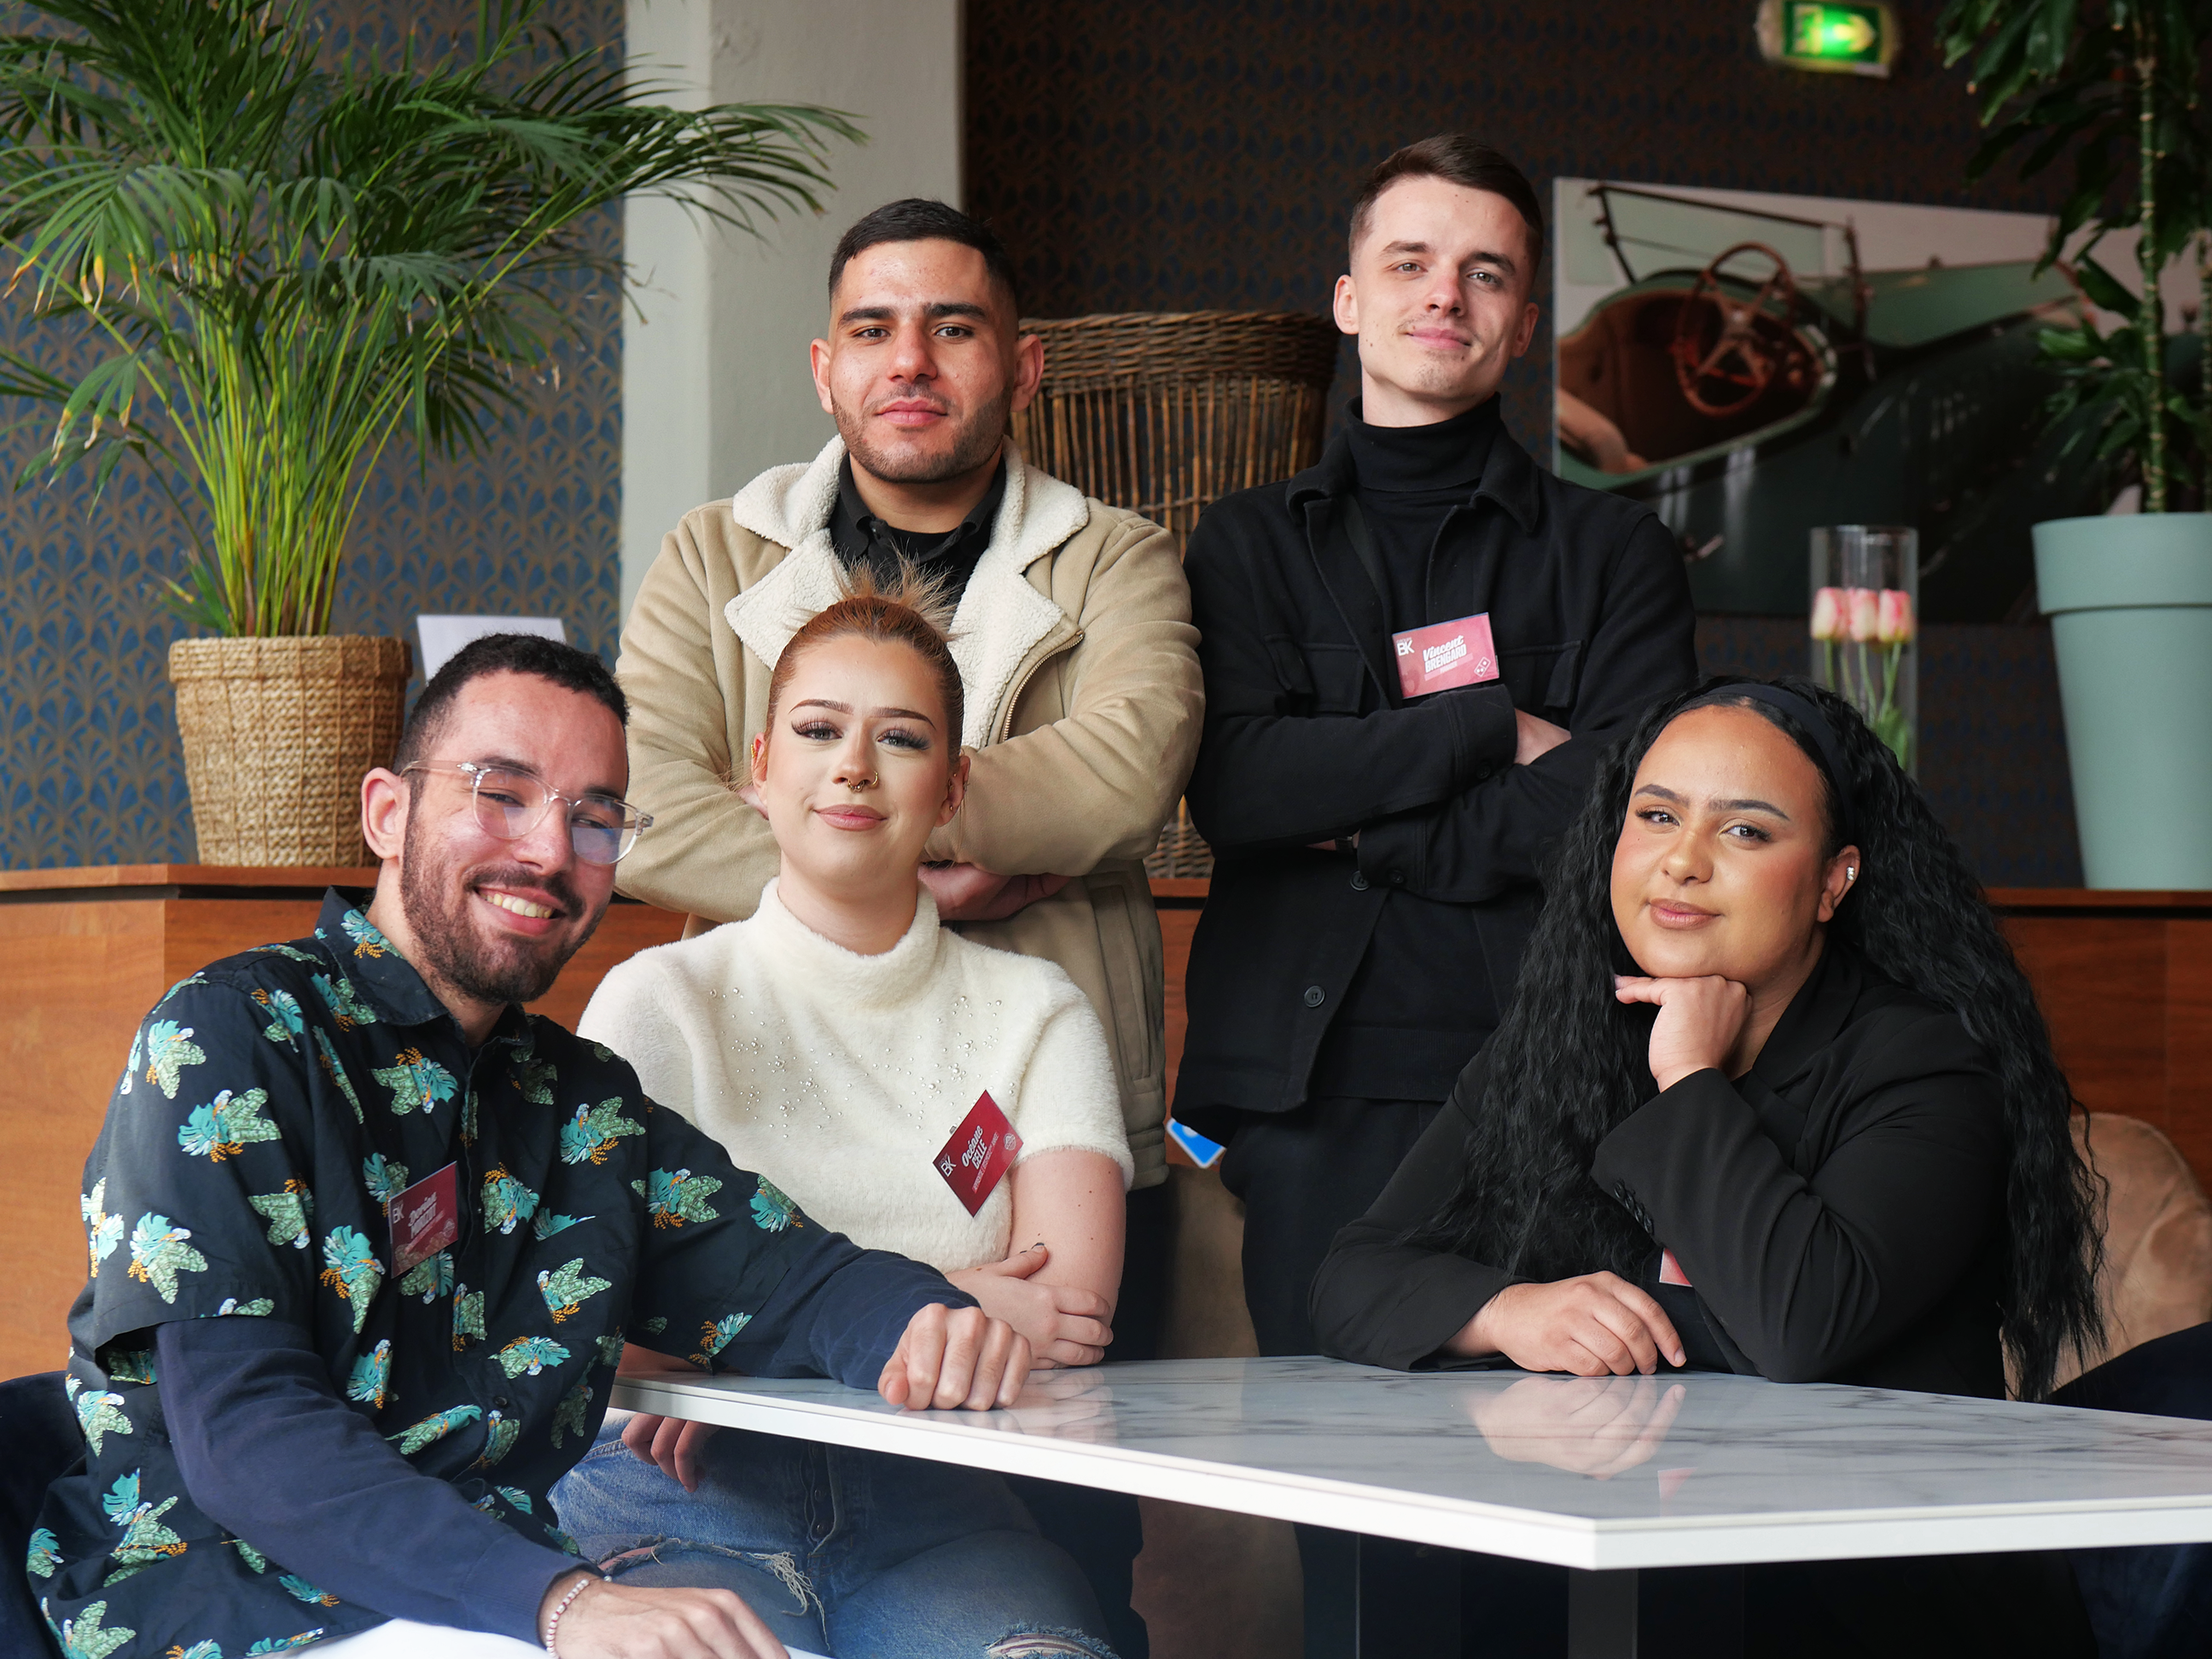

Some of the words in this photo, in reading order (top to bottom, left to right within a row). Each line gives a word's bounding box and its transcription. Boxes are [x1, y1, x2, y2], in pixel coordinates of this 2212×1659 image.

[1396, 640, 1415, 656] BK
[1423, 635, 1464, 661] Vincent
[1424, 643, 1467, 672] BRENGARD
[961, 1125, 983, 1167] Océane
[971, 1138, 987, 1170] CELLE
[940, 1155, 958, 1178] BK
[393, 1204, 405, 1224] BK
